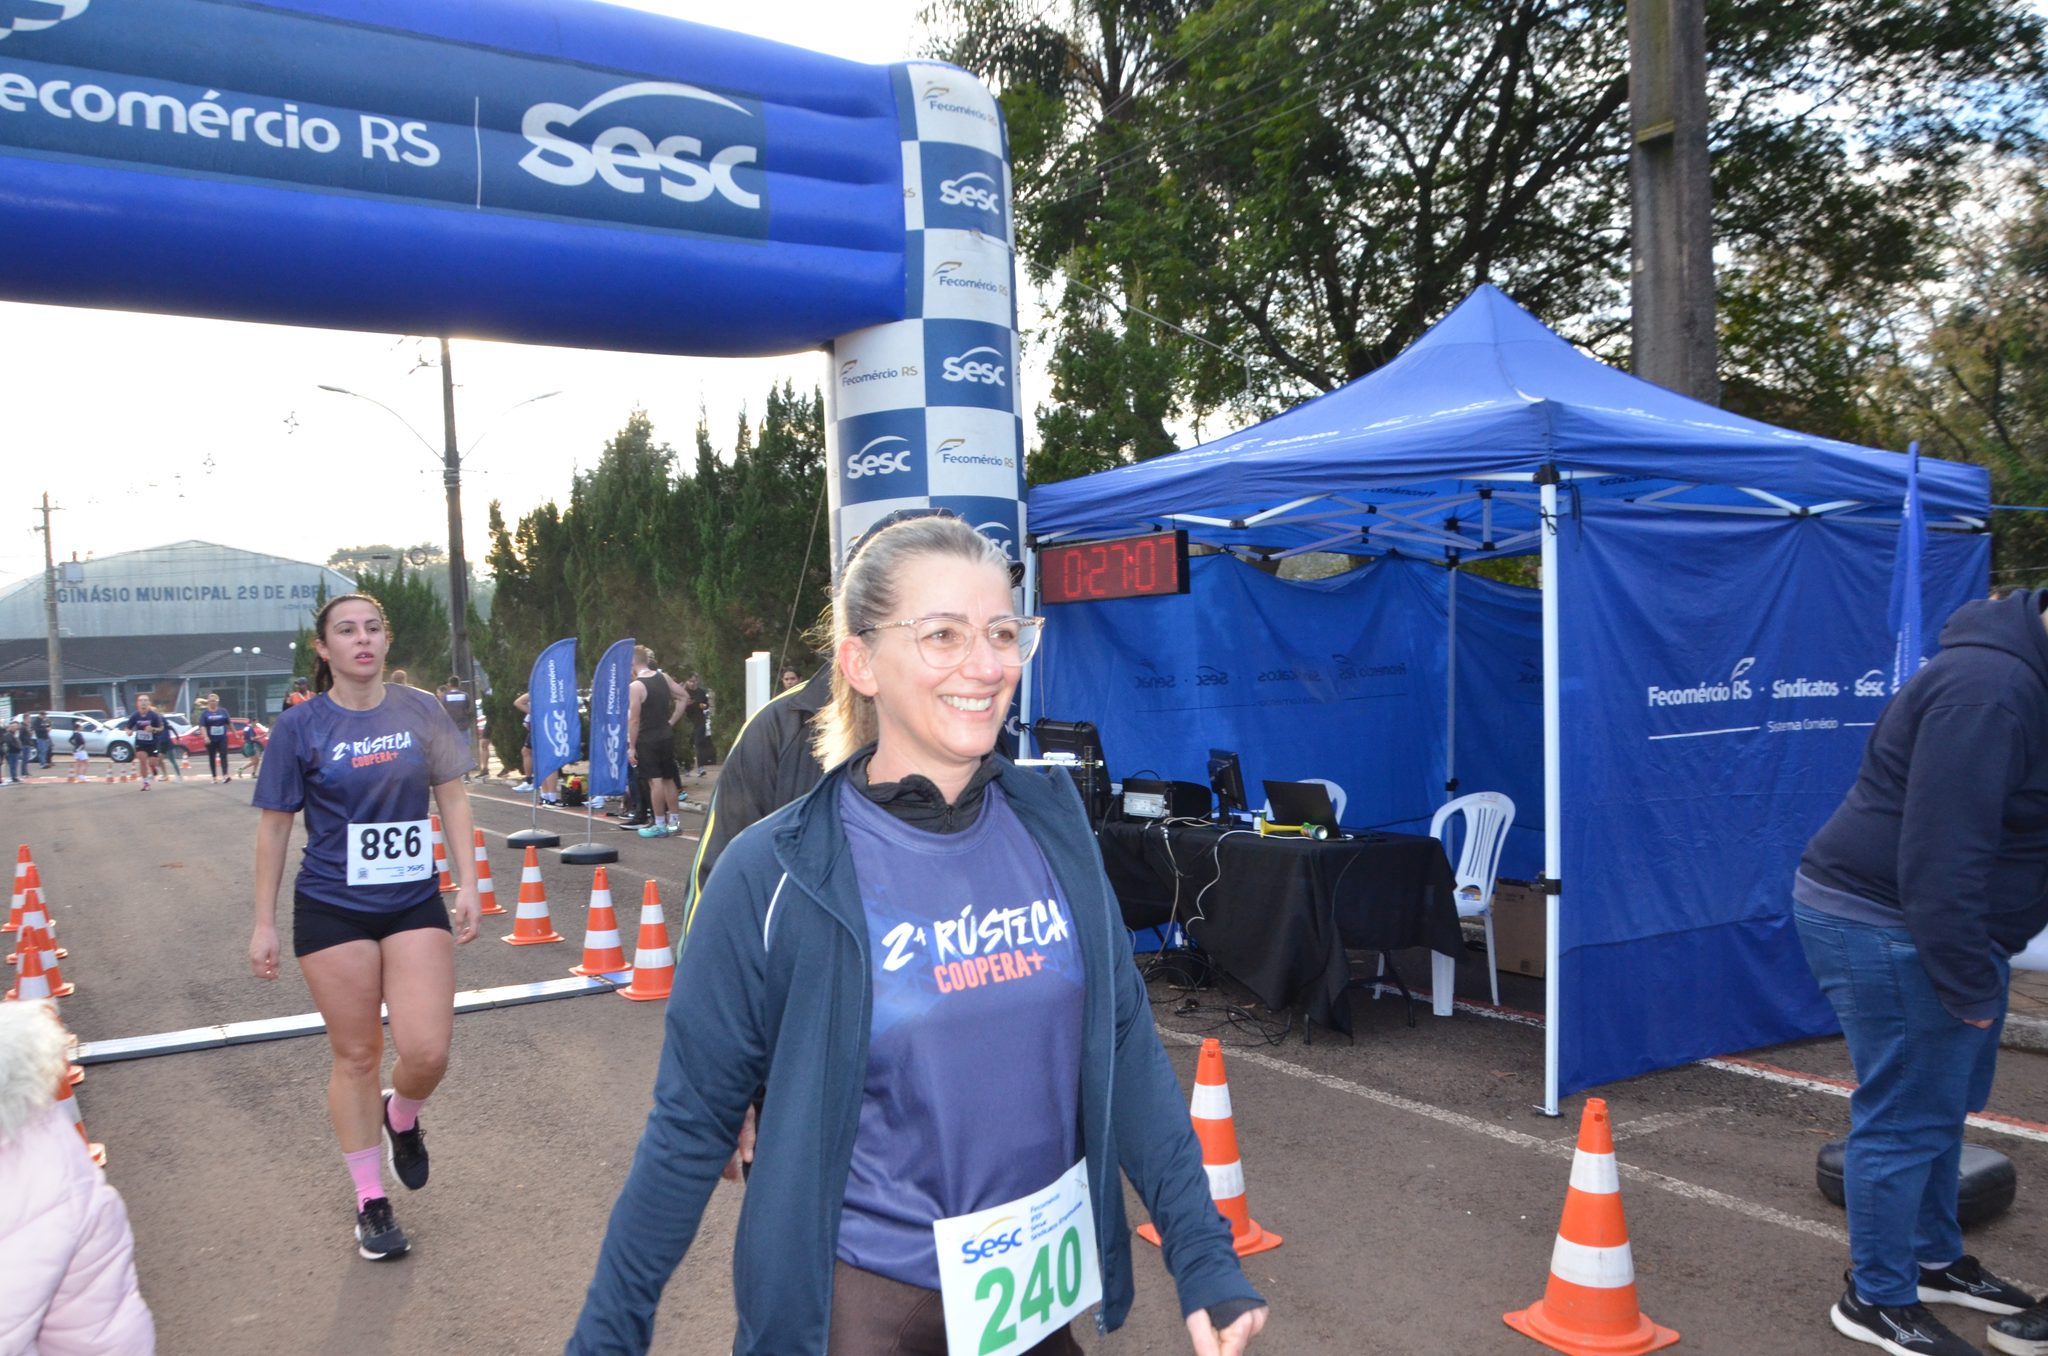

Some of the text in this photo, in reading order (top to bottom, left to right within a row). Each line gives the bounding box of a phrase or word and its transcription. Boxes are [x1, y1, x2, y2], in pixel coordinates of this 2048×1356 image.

[930, 100, 998, 127] Fecomércio RS
[360, 115, 441, 167] RS
[518, 100, 760, 208] Sesc
[940, 179, 1000, 214] Sesc
[940, 275, 1008, 296] Fecomércio RS
[841, 366, 918, 387] Fecomércio RS
[942, 356, 1005, 387] Sesc
[847, 450, 911, 479] Sesc
[943, 453, 1003, 466] Fecomércio
[1004, 458, 1015, 468] RS
[58, 584, 335, 602] GINÁSIO MUNICIPAL 29 DE ABRL
[1648, 677, 1885, 707] Fecomércio RS Sindicatos Sesc
[352, 731, 412, 757] RÚSTICA
[553, 710, 570, 757] Sesc
[608, 723, 621, 780] Sesc
[360, 826, 421, 861] 938
[933, 899, 1069, 965] RÚSTICA
[934, 948, 1046, 994] COOPERA+
[962, 1227, 1023, 1264] Sesc
[975, 1226, 1082, 1356] 240
